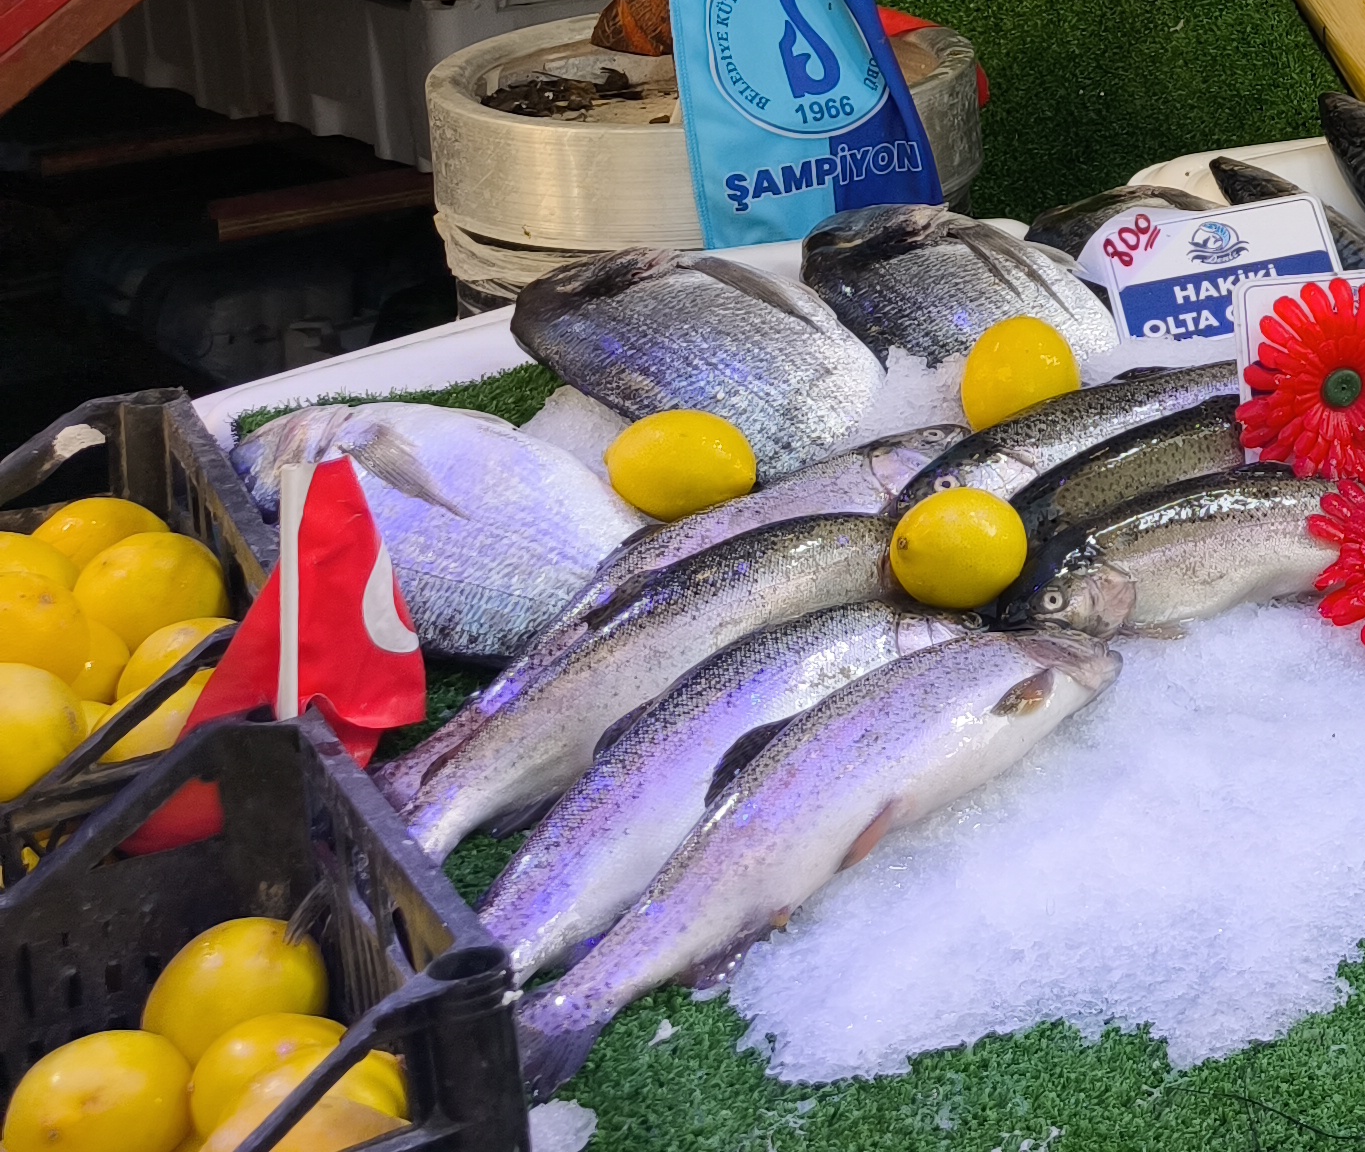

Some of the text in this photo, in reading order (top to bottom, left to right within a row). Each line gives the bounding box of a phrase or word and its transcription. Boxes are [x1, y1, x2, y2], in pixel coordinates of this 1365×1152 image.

[716, 30, 772, 112] BELEDİYE
[794, 94, 856, 125] 1966
[724, 140, 924, 215] ŞAMPİYON
[1103, 213, 1151, 267] 800
[1143, 309, 1221, 338] OLTA
